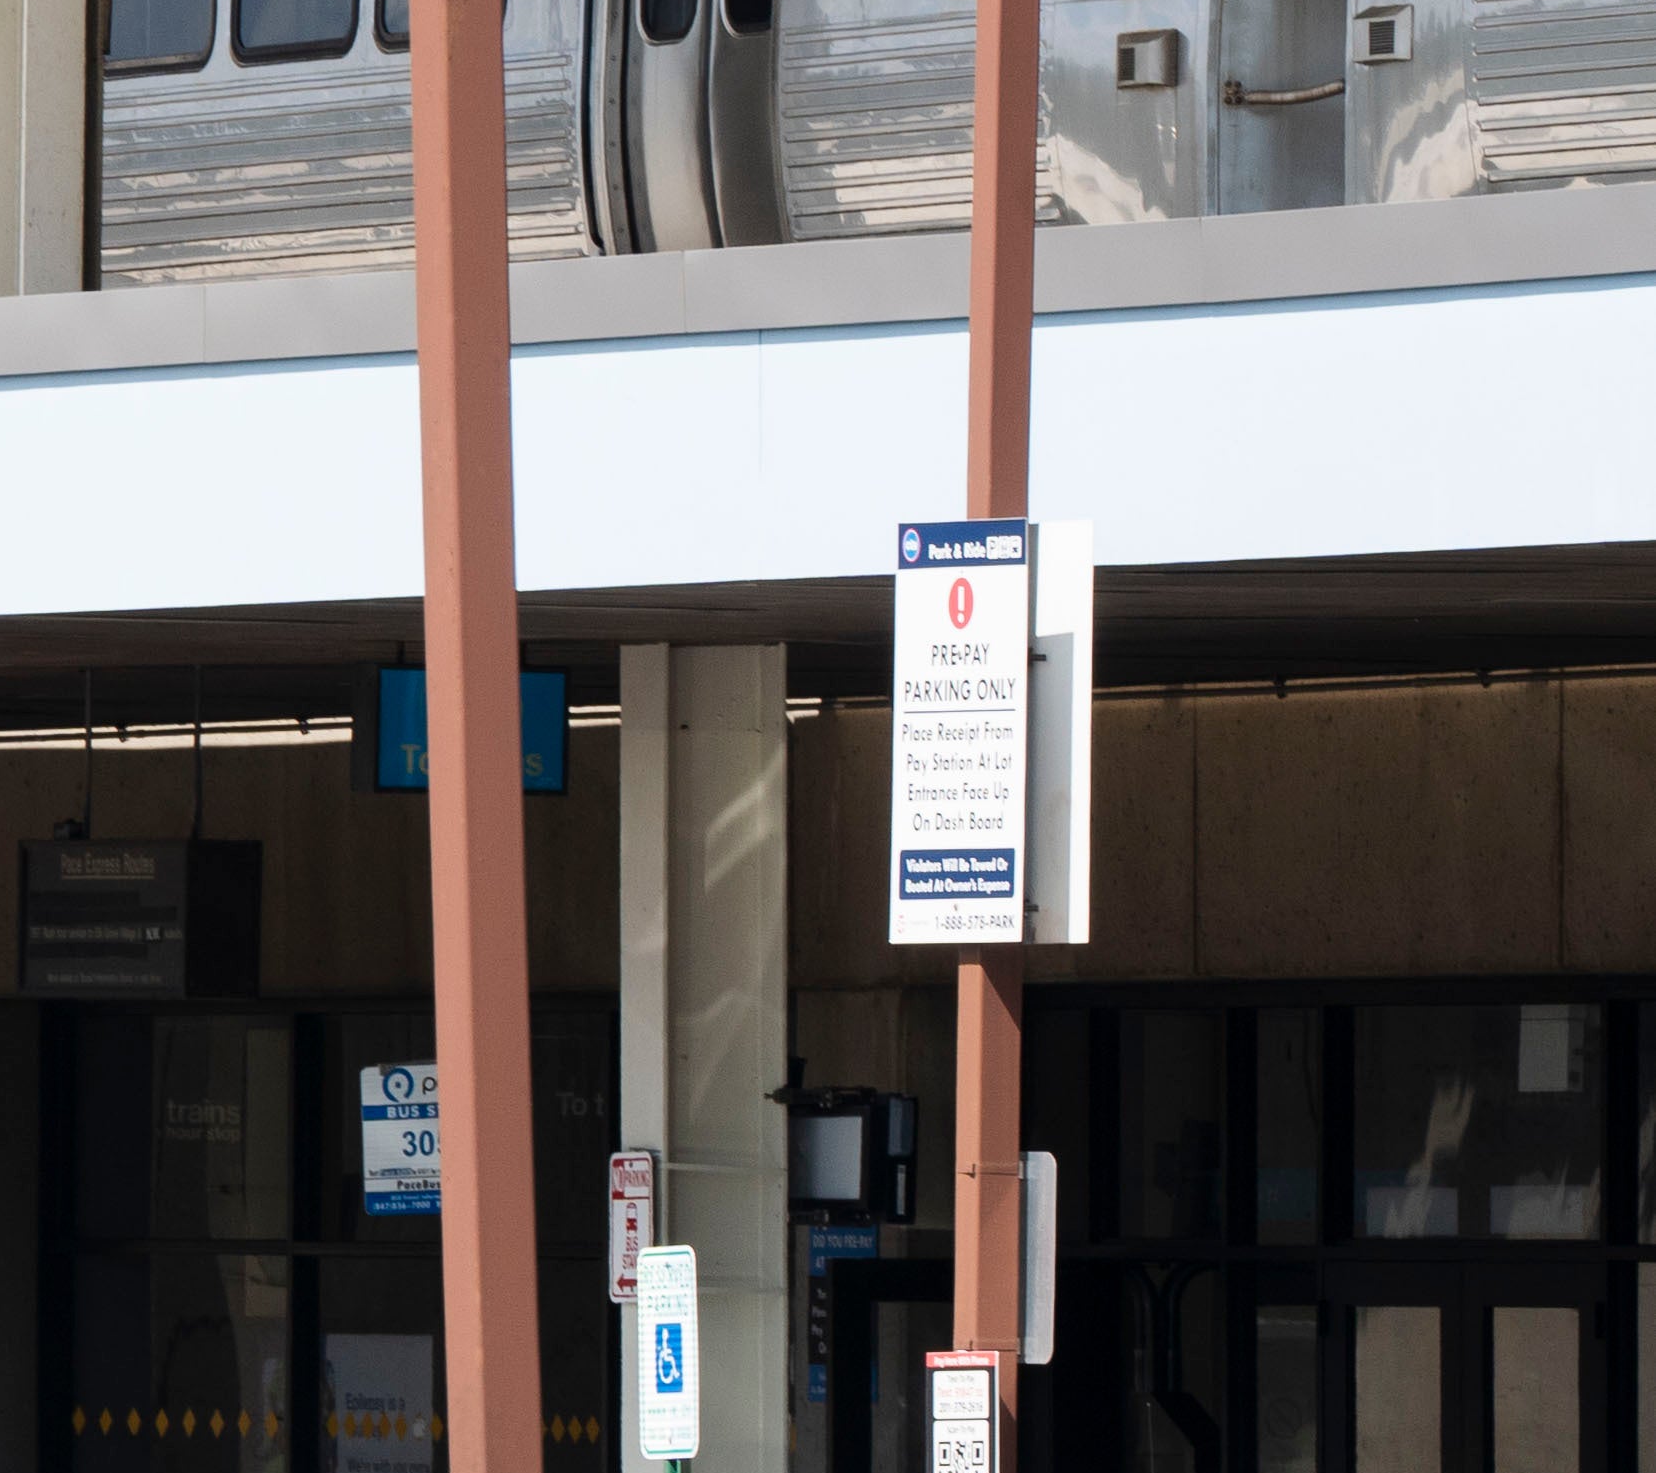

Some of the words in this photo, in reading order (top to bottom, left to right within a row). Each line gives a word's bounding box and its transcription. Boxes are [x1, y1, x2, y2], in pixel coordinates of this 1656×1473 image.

[904, 679, 972, 702] PARKING
[976, 678, 1016, 700] ONLY
[901, 723, 934, 742] Place
[937, 722, 980, 743] Receipt
[984, 722, 1015, 740] From
[906, 753, 929, 777] Pay
[933, 753, 974, 771] Station
[978, 753, 991, 770] At
[994, 753, 1013, 770] Lot
[908, 783, 958, 802] Entrance
[962, 784, 990, 801] Face
[993, 783, 1010, 805] Up
[913, 813, 930, 832] On
[934, 812, 965, 831] Dash
[969, 812, 1004, 830] Board
[165, 1098, 241, 1125] trains
[386, 1105, 420, 1119] BUS
[402, 1130, 441, 1157] 30
